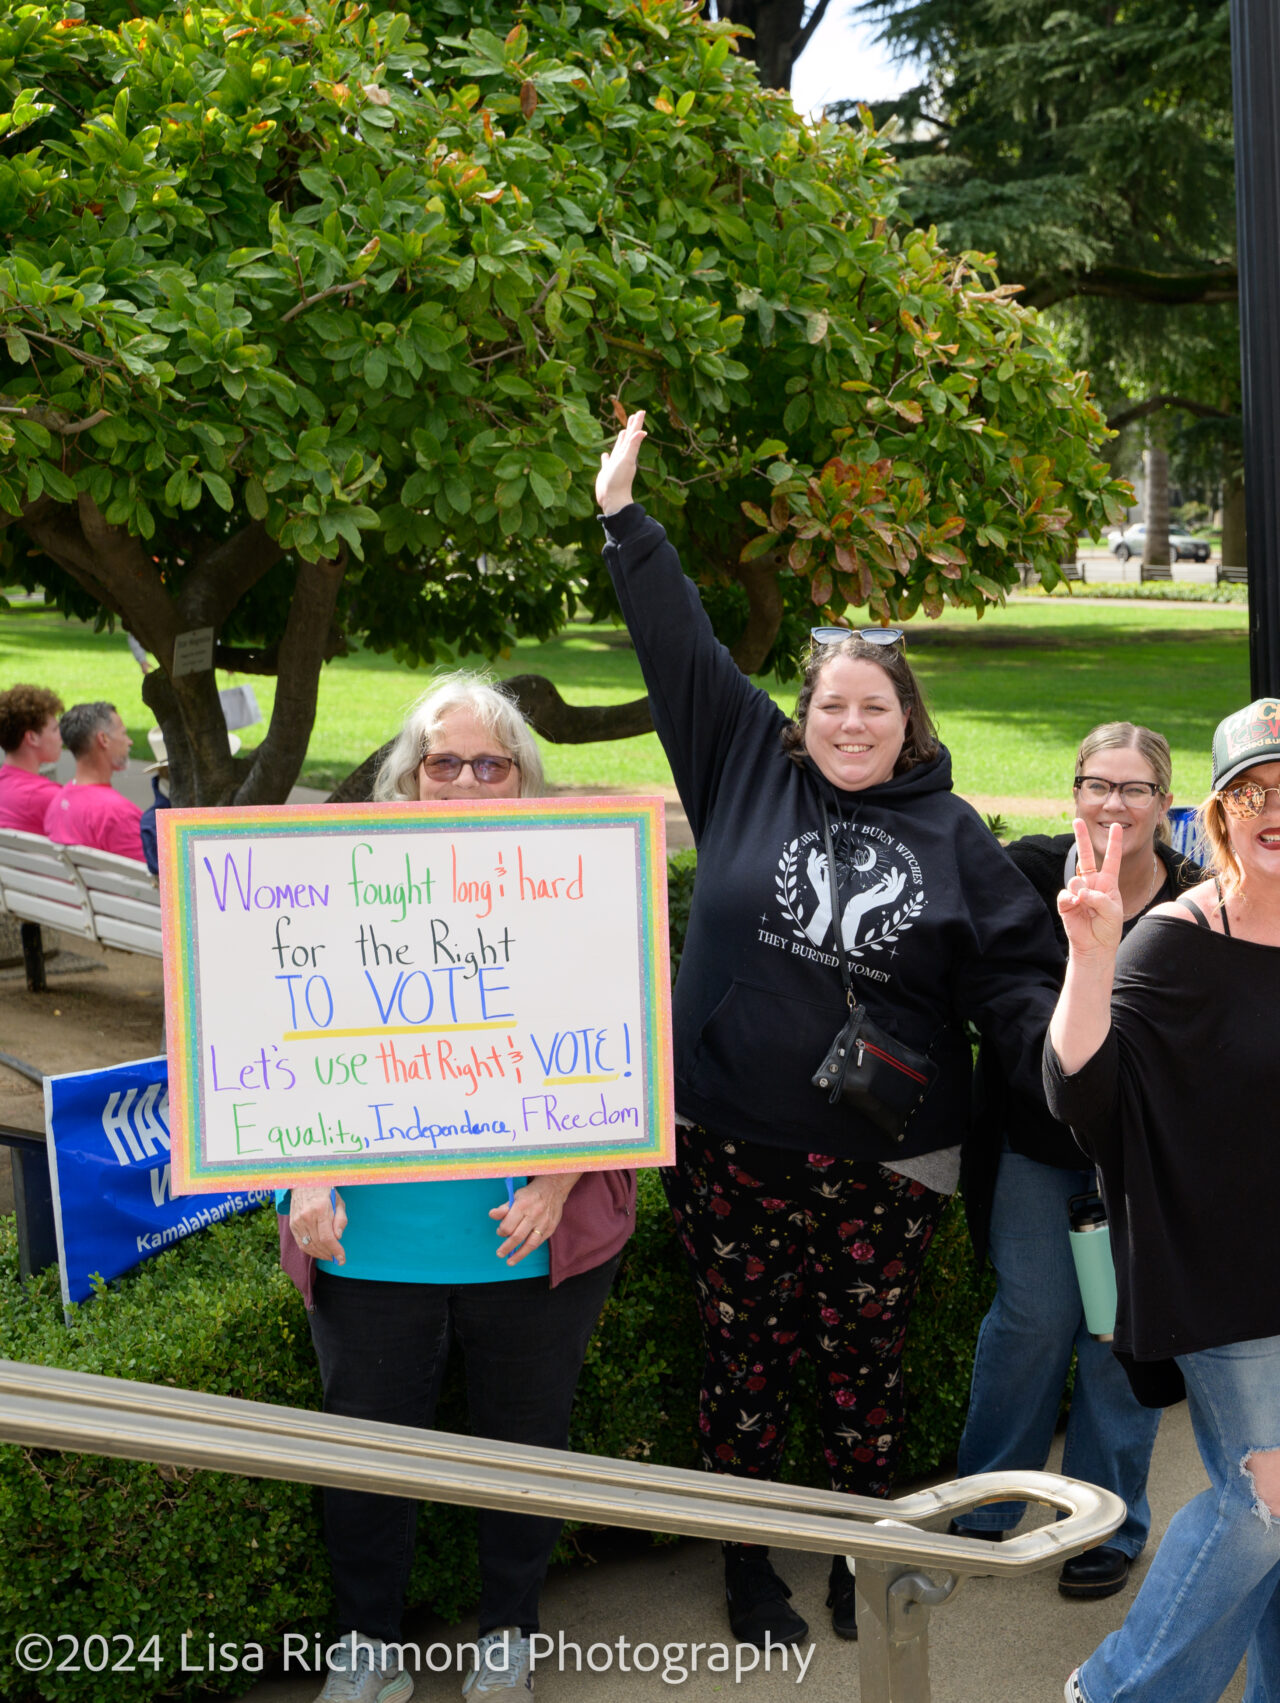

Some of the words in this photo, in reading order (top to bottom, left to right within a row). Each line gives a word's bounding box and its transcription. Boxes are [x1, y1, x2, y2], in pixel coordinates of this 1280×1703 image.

[347, 842, 436, 923] fought
[451, 843, 492, 919] long
[517, 845, 584, 900] hard
[861, 825, 895, 846] BURN
[895, 842, 923, 886] WITCHES
[271, 915, 326, 969] for
[355, 924, 415, 967] the
[430, 918, 516, 980] Right
[758, 929, 788, 950] THEY
[791, 942, 840, 968] BURNED
[275, 974, 334, 1030] TO
[364, 967, 515, 1025] VOTE
[210, 1044, 296, 1092] Let's
[315, 1053, 368, 1086] use
[375, 1039, 431, 1084] that
[437, 1039, 502, 1096] Right
[232, 1102, 370, 1156] Equality,
[136, 1187, 275, 1253] KamalaHarris.com
